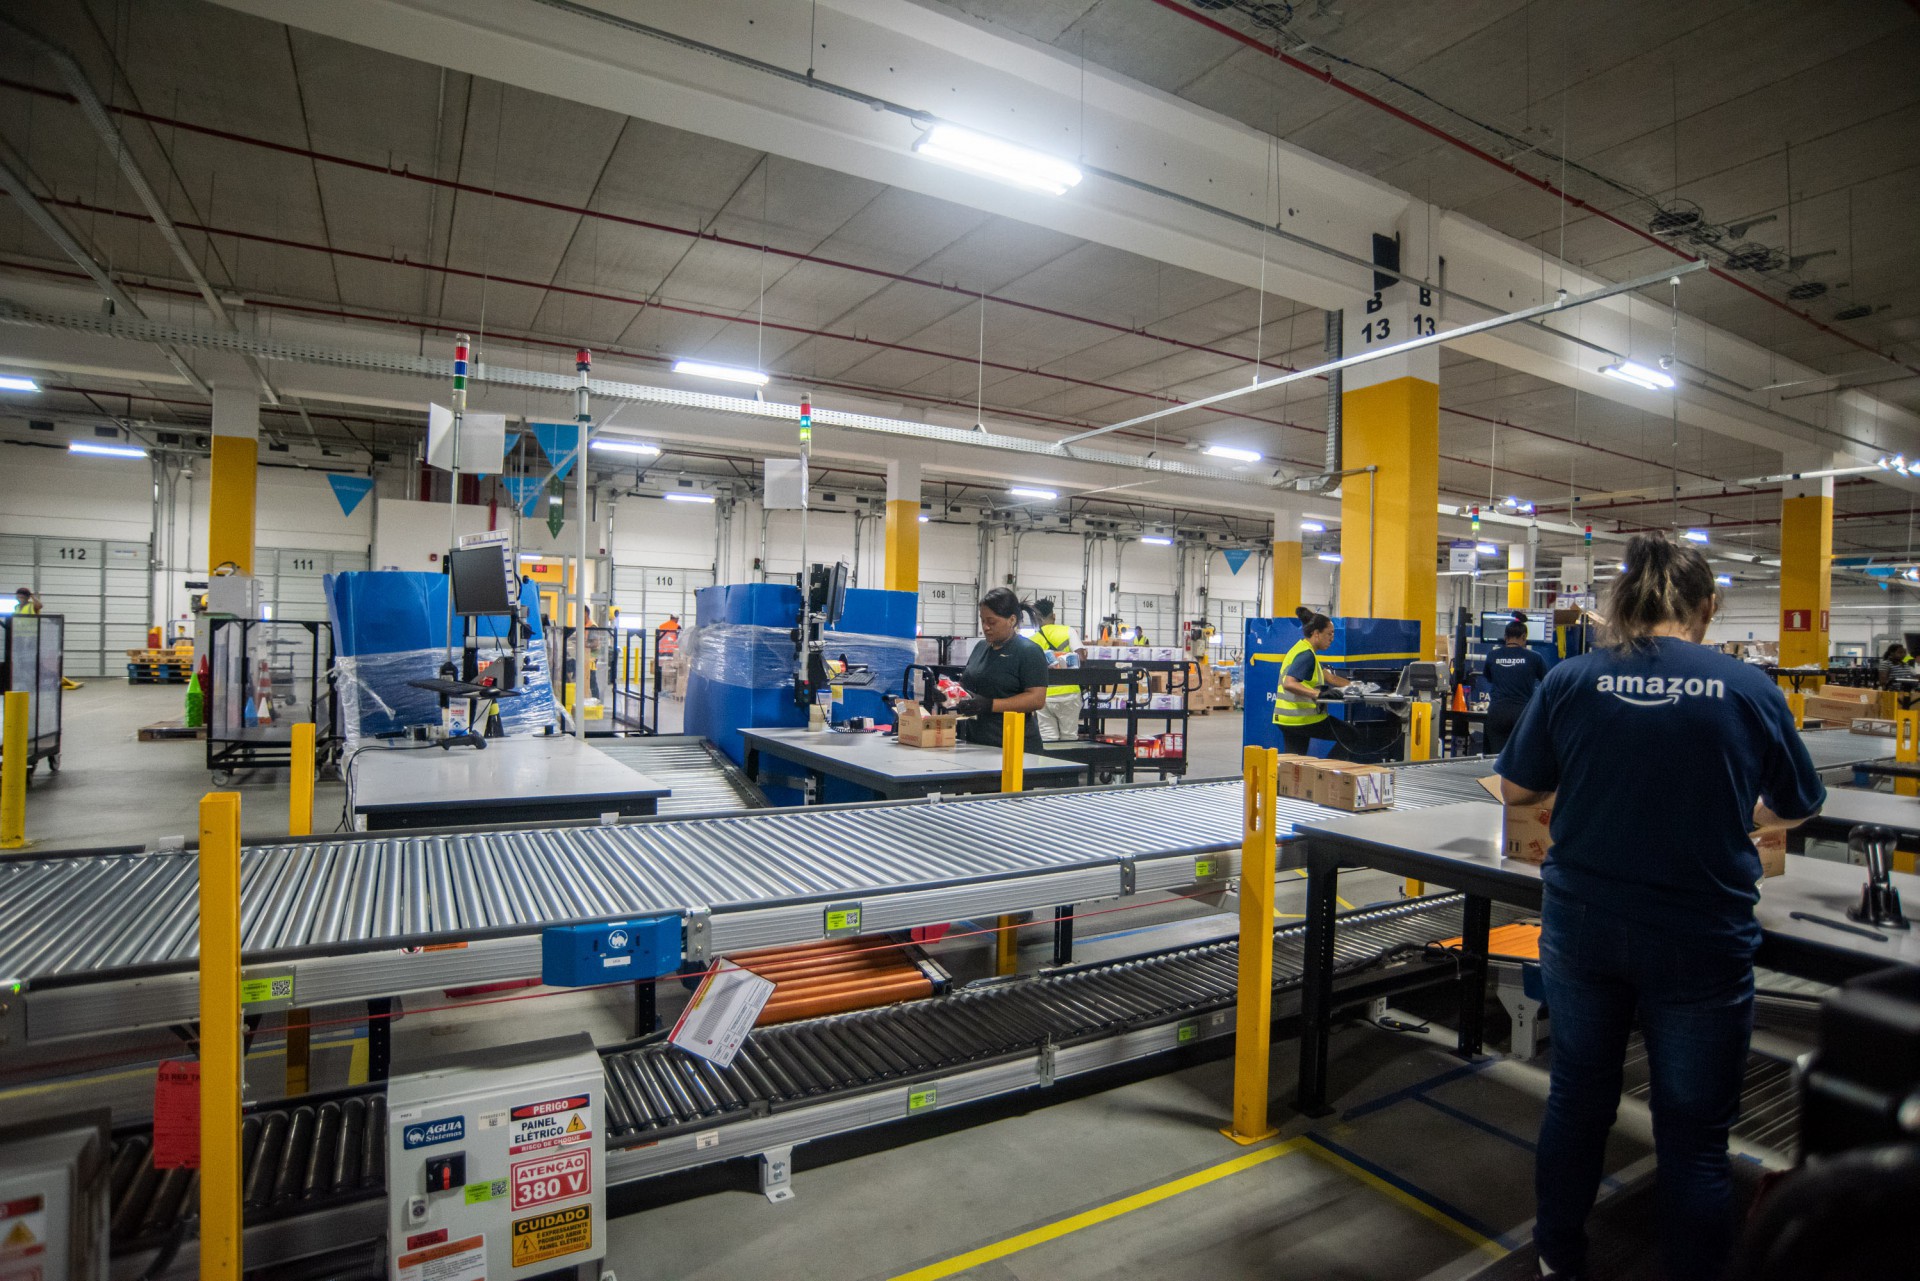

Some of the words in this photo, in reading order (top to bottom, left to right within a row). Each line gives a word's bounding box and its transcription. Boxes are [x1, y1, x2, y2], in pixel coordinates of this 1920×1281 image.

[1366, 291, 1383, 314] B
[1419, 287, 1432, 307] B
[1361, 318, 1391, 344] 13
[1413, 314, 1436, 337] 13
[59, 548, 86, 560] 112
[293, 559, 313, 570] 111
[656, 576, 673, 586] 110
[932, 590, 946, 599] 108
[1142, 600, 1154, 609] 106
[1596, 674, 1725, 699] amazon
[1478, 691, 1491, 701] PA
[533, 1100, 569, 1115] PERIGO
[425, 1120, 462, 1136] ÁGUIA
[521, 1116, 557, 1131] PAINEL
[425, 1131, 462, 1142] Sistemas
[514, 1126, 564, 1144] ELÉTRICO
[521, 1143, 542, 1152] RISCO
[553, 1135, 581, 1145] CHOQUE
[518, 1157, 584, 1180] ATENÇÃO
[518, 1178, 561, 1203] 380
[567, 1172, 584, 1191] V
[518, 1209, 586, 1233] CUIDADO
[537, 1234, 565, 1245] PROIBIDO
